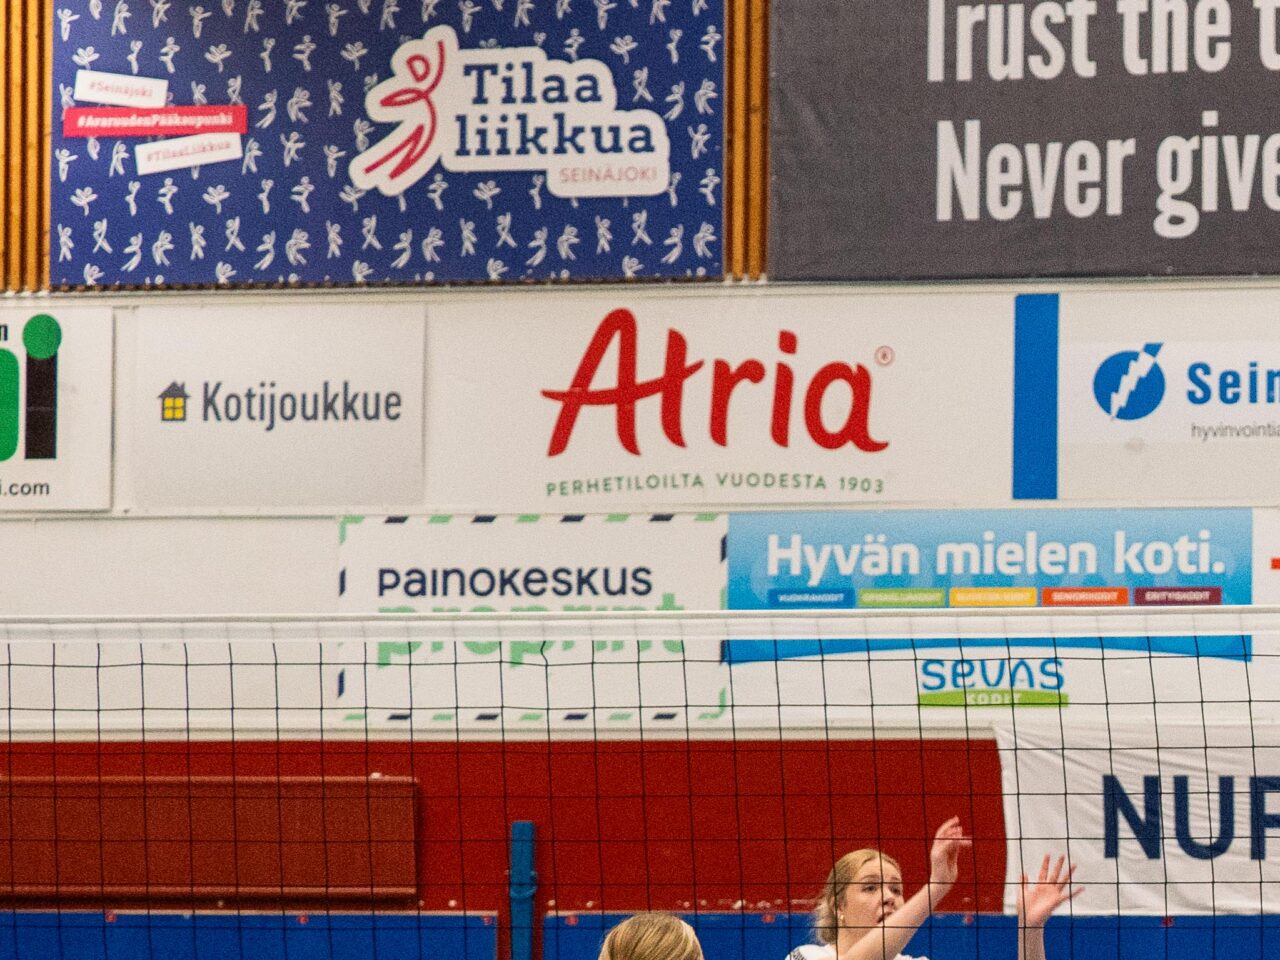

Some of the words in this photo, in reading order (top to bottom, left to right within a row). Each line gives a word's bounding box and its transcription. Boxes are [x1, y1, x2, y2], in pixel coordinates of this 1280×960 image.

[927, 0, 1098, 82] Trust
[1116, 0, 1232, 76] the
[463, 62, 602, 105] Tilaa
[455, 112, 655, 156] liikkua
[559, 165, 657, 183] SEINÄJOKI
[936, 118, 1136, 222] Never
[202, 380, 401, 431] Kotijoukkue
[540, 308, 889, 457] Atria
[546, 473, 704, 496] PERHETILOILTA
[716, 473, 827, 490] VUODESTA
[839, 476, 885, 494] 1903
[767, 531, 920, 586] Hyvän
[936, 531, 1097, 577] mielen
[1114, 529, 1226, 575] koti.
[966, 692, 1022, 705] KODIT
